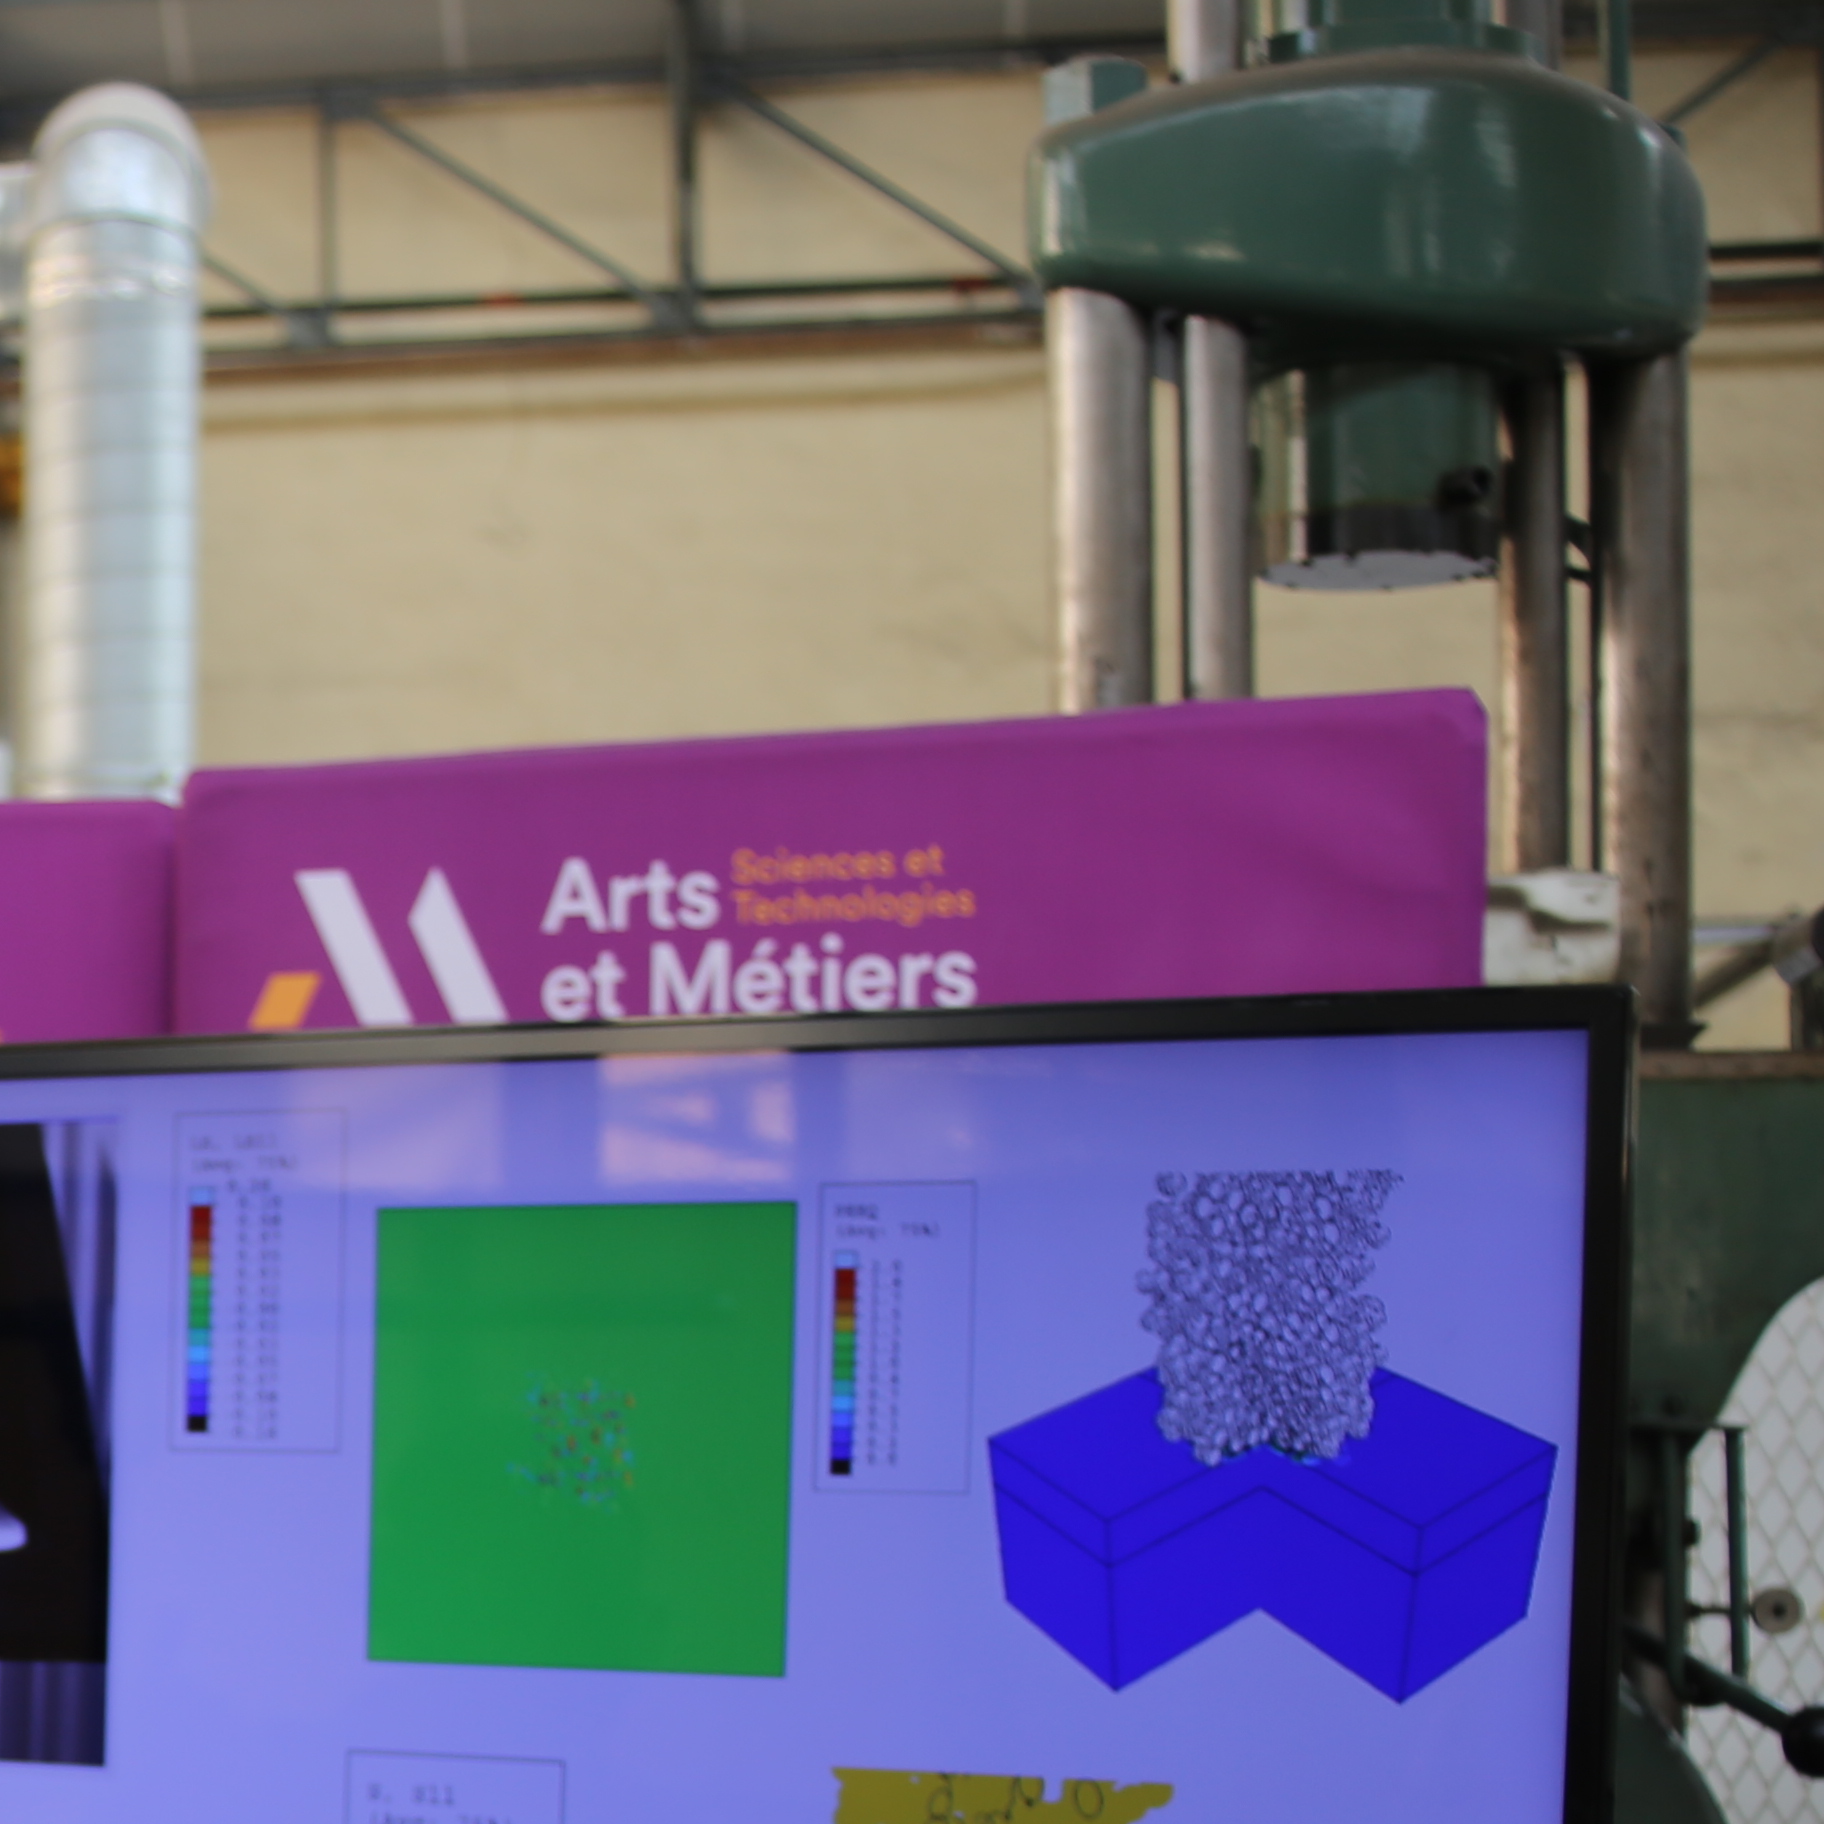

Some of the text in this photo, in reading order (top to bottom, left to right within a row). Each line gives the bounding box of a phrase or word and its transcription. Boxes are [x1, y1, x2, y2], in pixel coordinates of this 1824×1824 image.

[731, 843, 945, 884] Sciences et
[540, 856, 721, 935] Arts
[732, 882, 978, 928] Technologies
[540, 930, 979, 1023] et Métiers
